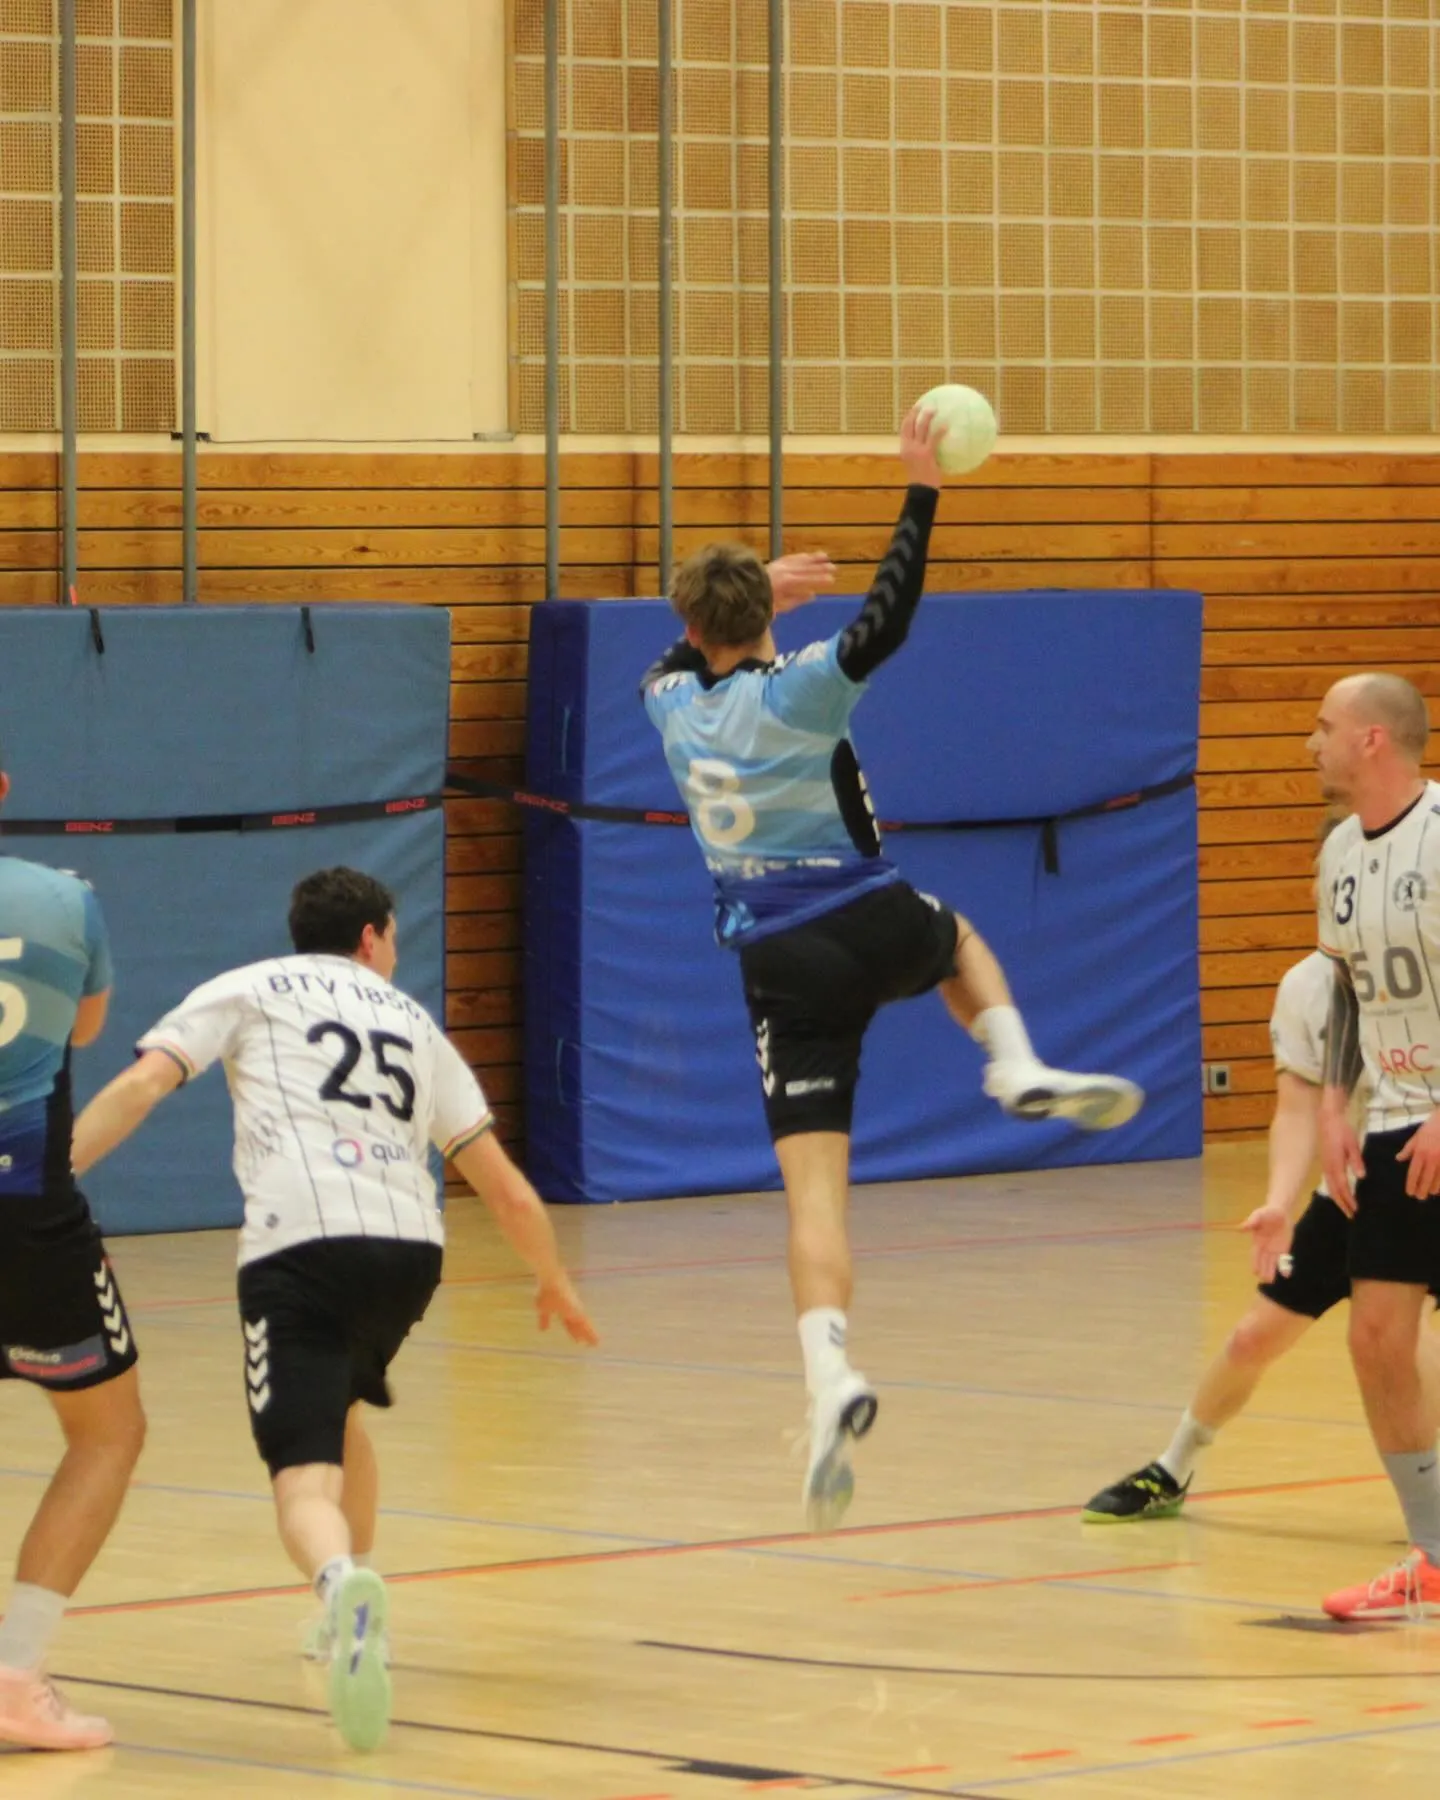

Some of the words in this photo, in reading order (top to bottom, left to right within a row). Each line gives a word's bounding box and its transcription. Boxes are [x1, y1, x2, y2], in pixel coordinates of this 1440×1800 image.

[688, 758, 756, 848] 8
[268, 972, 335, 994] BTV
[306, 1020, 416, 1122] 25
